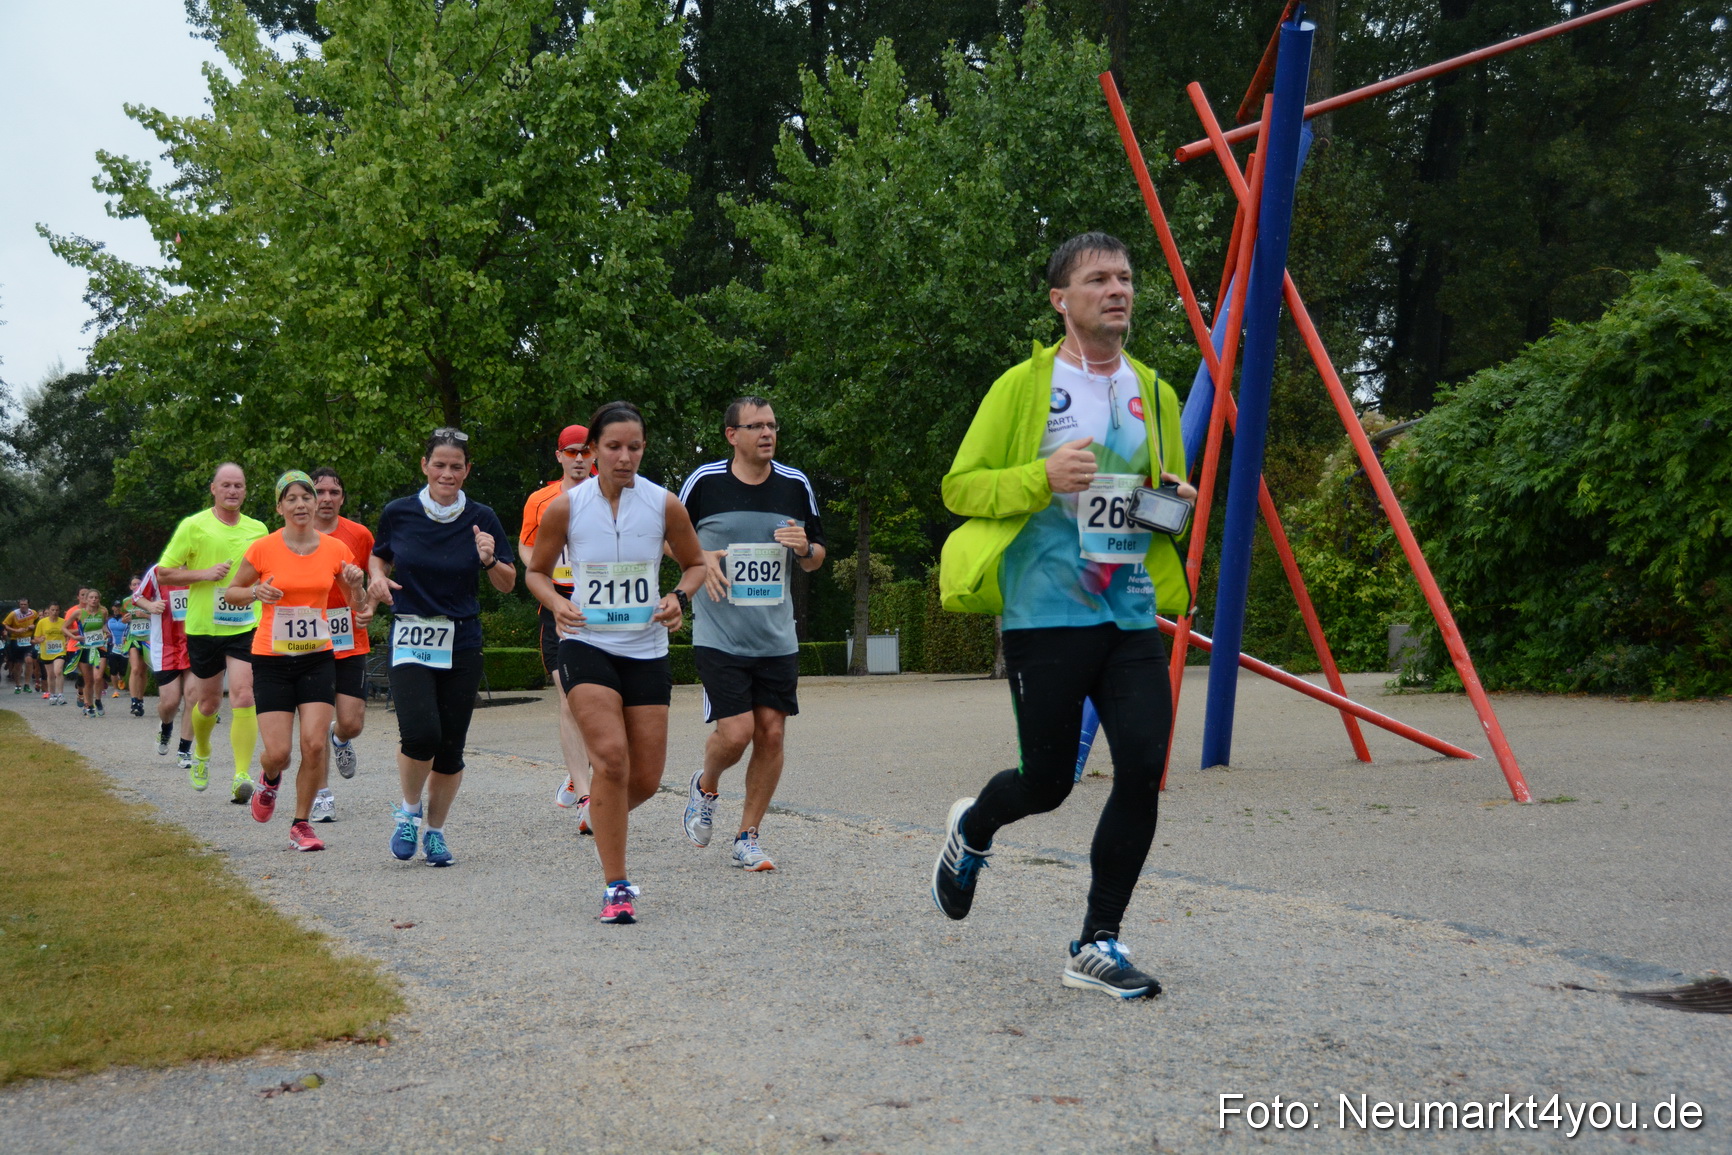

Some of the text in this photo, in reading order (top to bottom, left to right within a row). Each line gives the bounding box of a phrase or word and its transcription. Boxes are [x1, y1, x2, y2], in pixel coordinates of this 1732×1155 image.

[1046, 415, 1077, 428] PARTL
[1048, 423, 1078, 434] Neumarkt
[1107, 537, 1137, 551] Peter
[734, 560, 781, 582] 2692
[588, 577, 649, 605] 2110
[747, 587, 770, 596] Dieter
[607, 612, 630, 622] Nina
[132, 622, 150, 630] 2878
[284, 618, 318, 638] 131
[397, 626, 449, 647] 2027
[47, 642, 62, 650] 3094
[287, 642, 316, 651] Claudia
